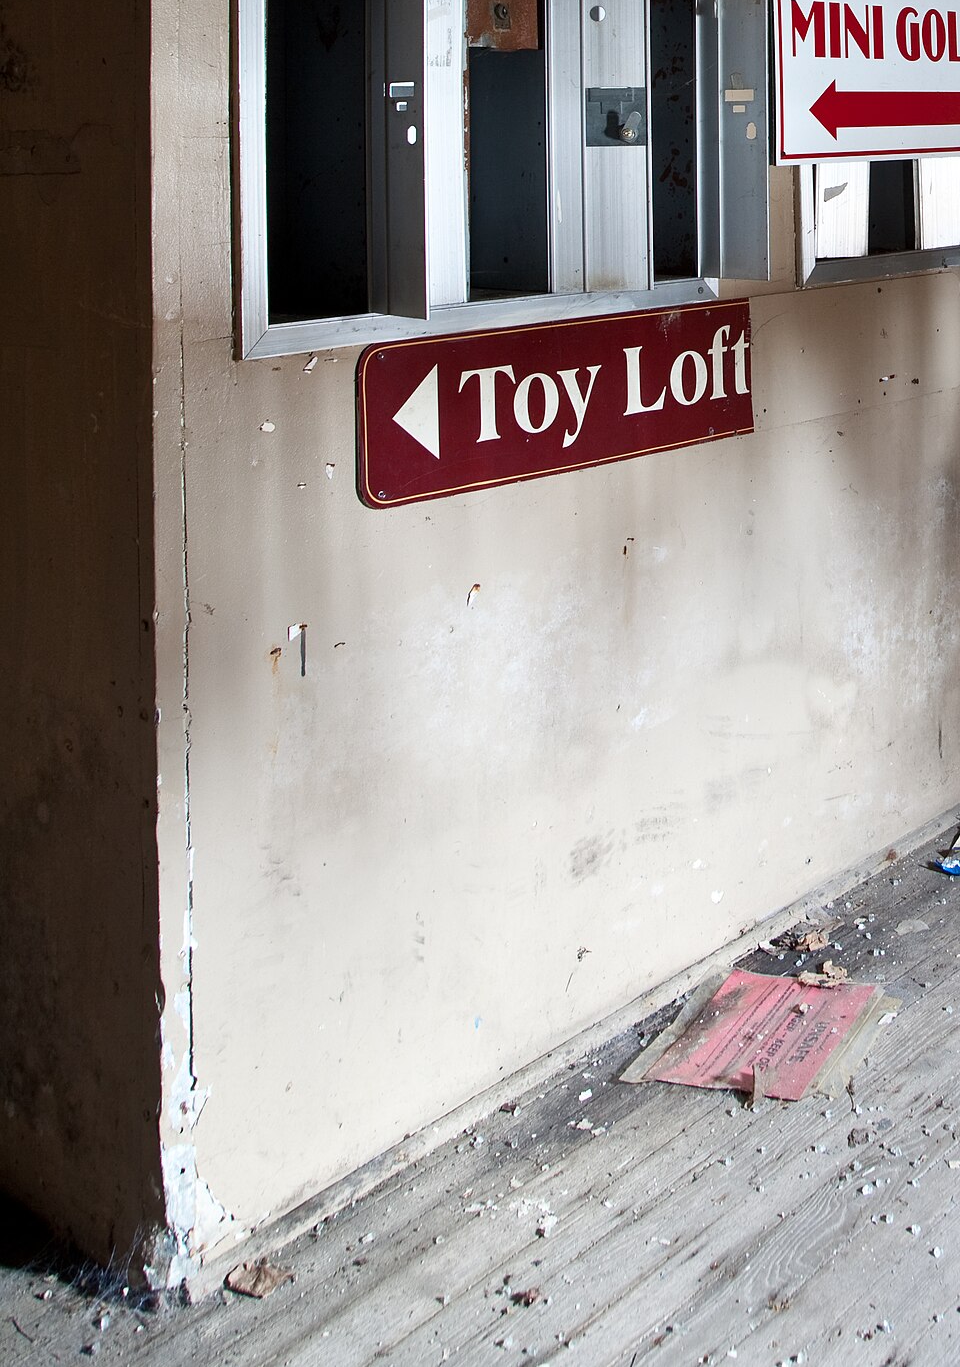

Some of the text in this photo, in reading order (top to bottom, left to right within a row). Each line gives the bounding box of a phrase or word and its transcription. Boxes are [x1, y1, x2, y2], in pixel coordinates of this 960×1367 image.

[791, 0, 884, 60] MINI
[458, 324, 750, 448] Toy Loft
[788, 1021, 830, 1063] UNSAFE
